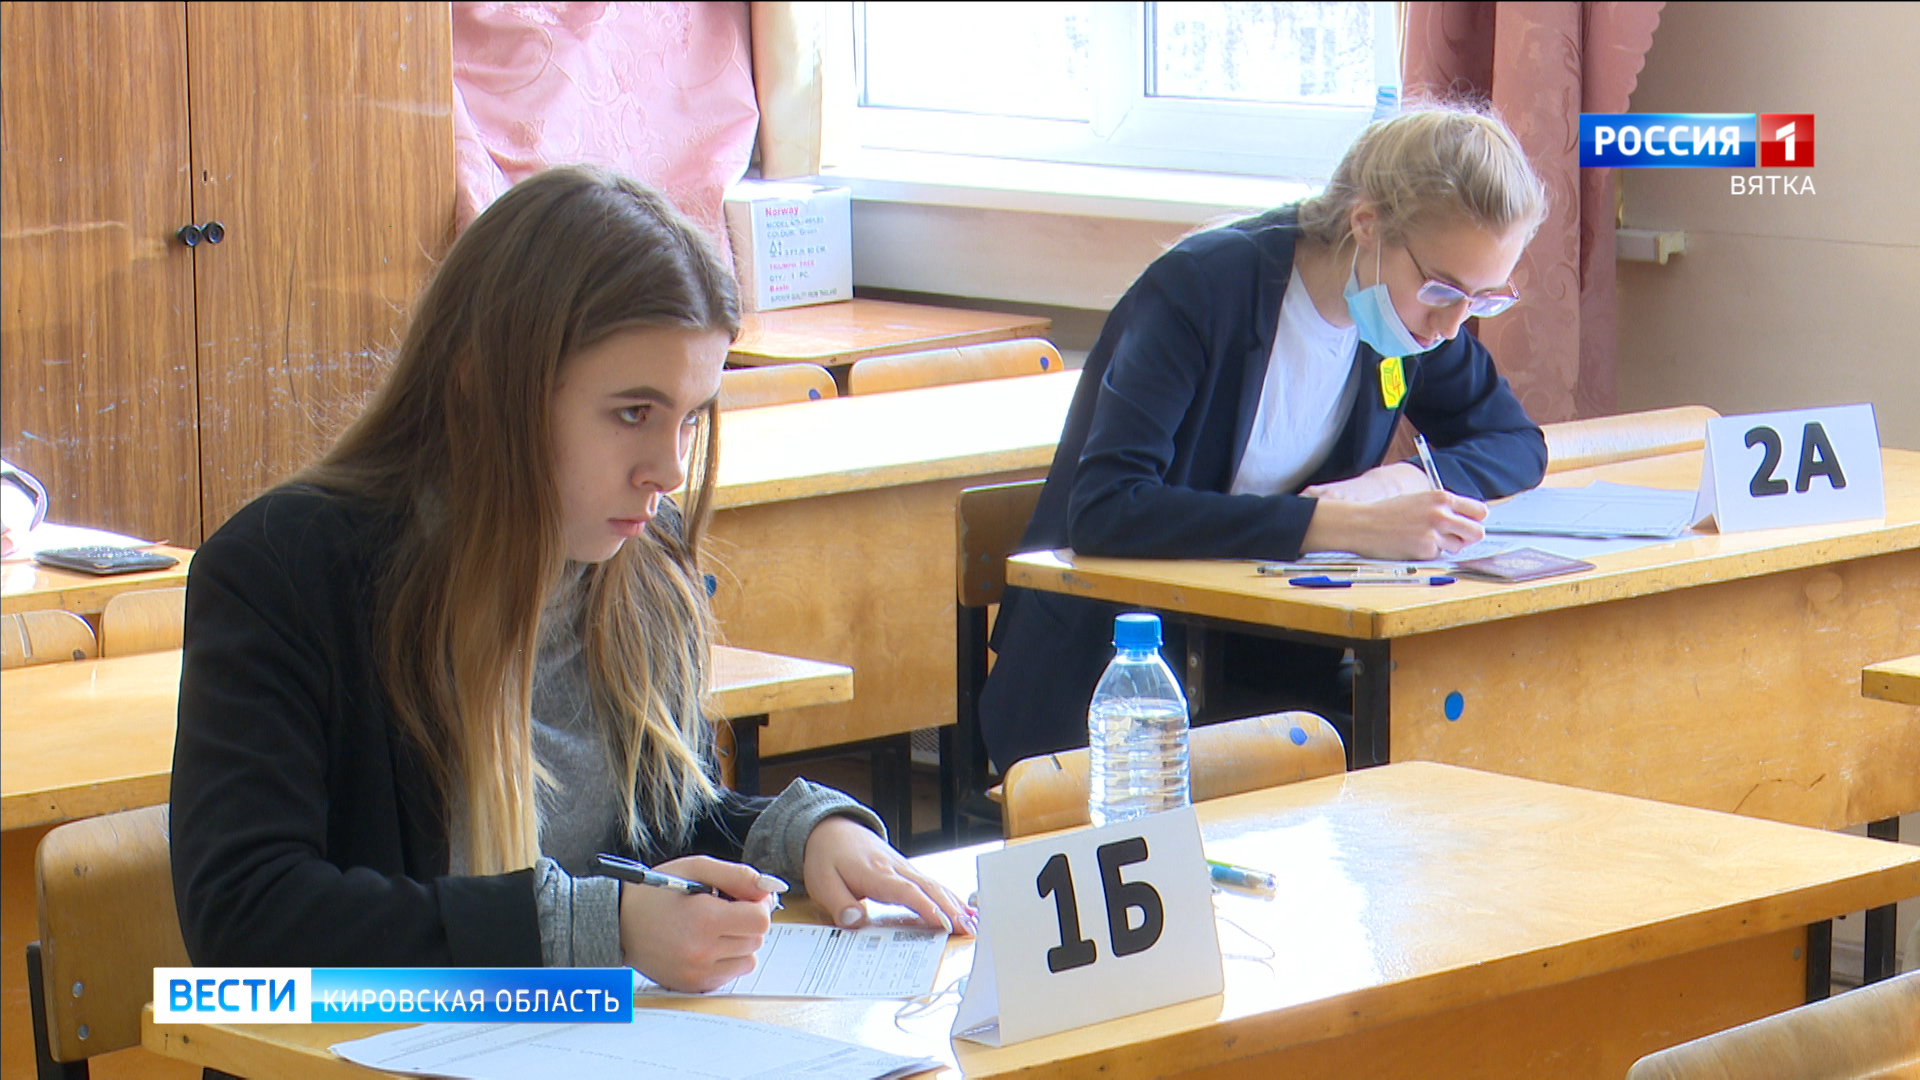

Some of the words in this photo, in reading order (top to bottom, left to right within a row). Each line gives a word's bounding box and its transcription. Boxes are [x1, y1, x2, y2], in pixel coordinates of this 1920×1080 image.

[765, 207, 799, 216] Norway
[1743, 420, 1847, 498] 2А
[1036, 836, 1164, 974] 1Б
